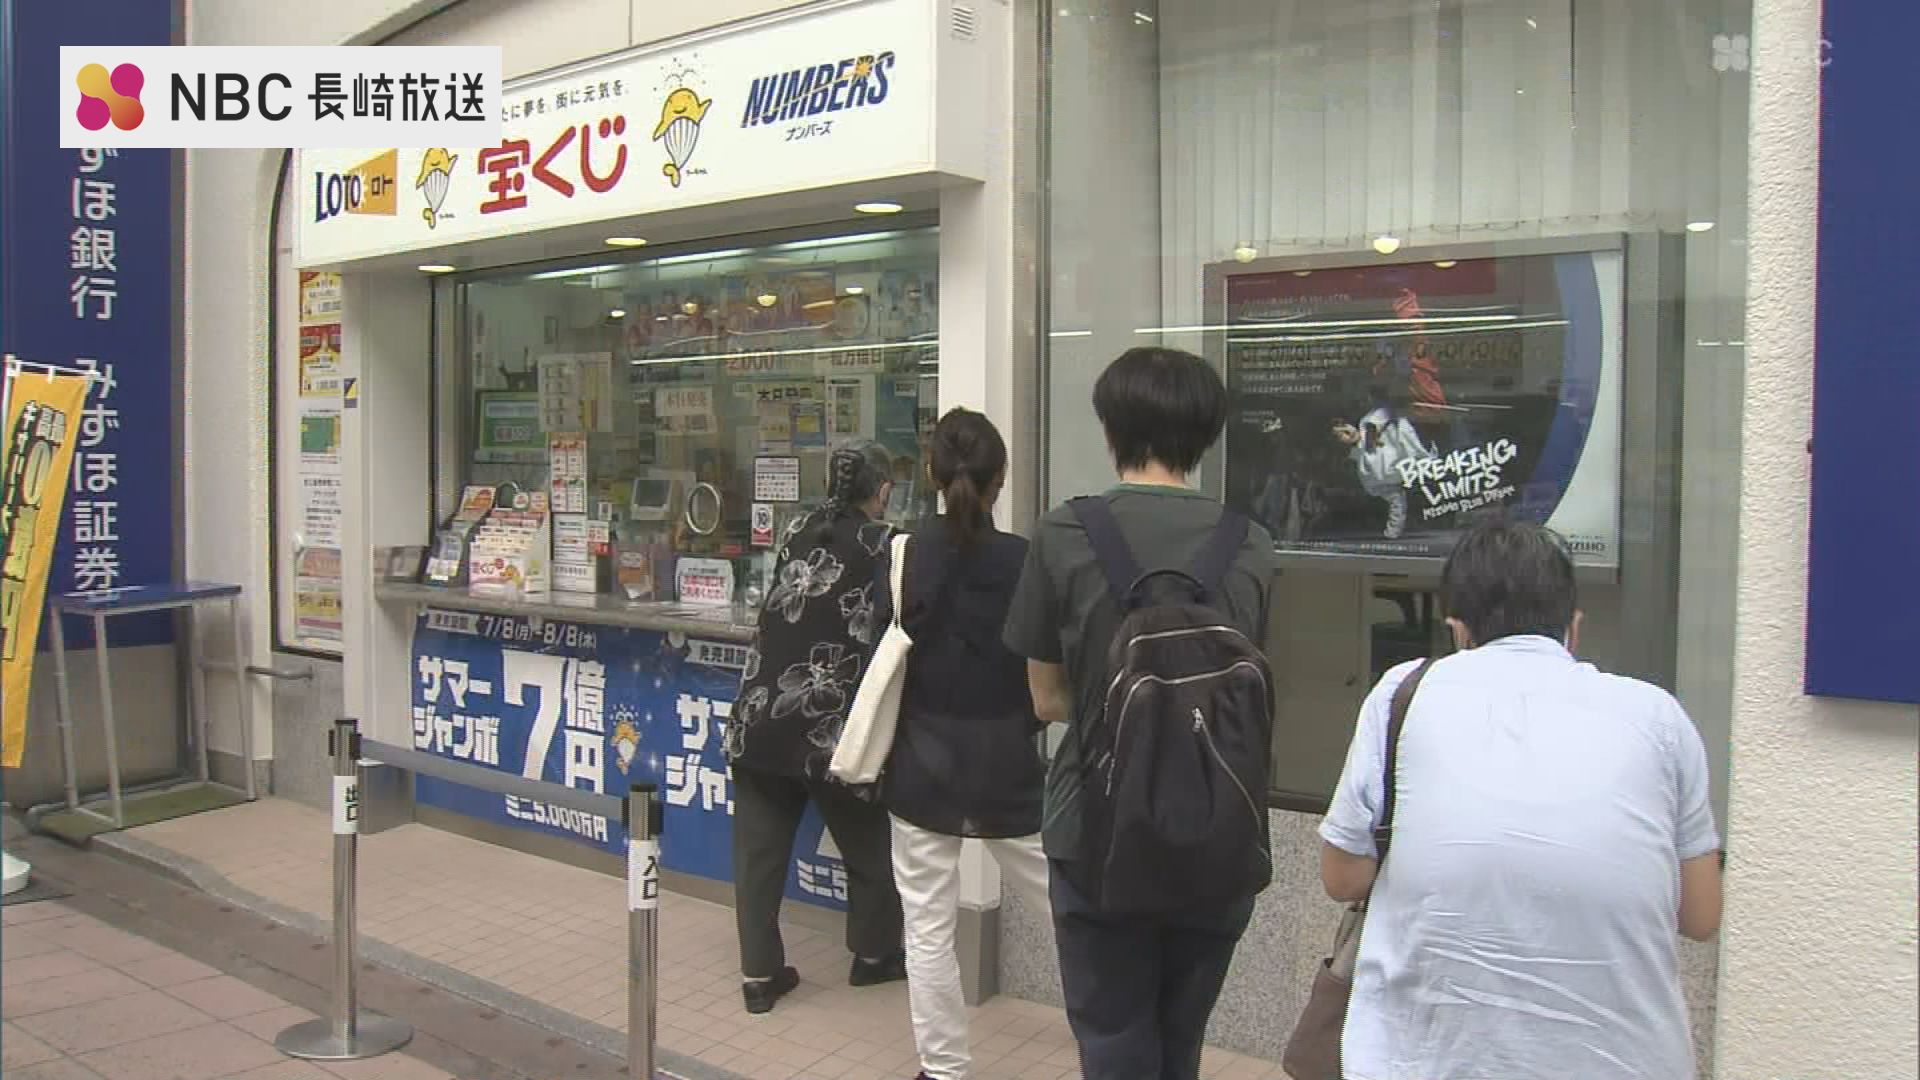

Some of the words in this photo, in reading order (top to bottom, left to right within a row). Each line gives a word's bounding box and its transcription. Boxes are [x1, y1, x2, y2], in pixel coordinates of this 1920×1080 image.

[740, 51, 895, 128] NUMBERS
[785, 120, 834, 142] ナンバーズ
[371, 176, 394, 196] ロト
[478, 115, 627, 214] 宝くじ
[315, 171, 361, 222] LOTO
[74, 359, 119, 594] みずほ証券
[1397, 438, 1517, 489] BREAKING
[1421, 465, 1501, 506] LIMITS
[418, 655, 492, 707] サマー
[414, 706, 500, 765] ジャンボ
[643, 855, 659, 900] 入口
